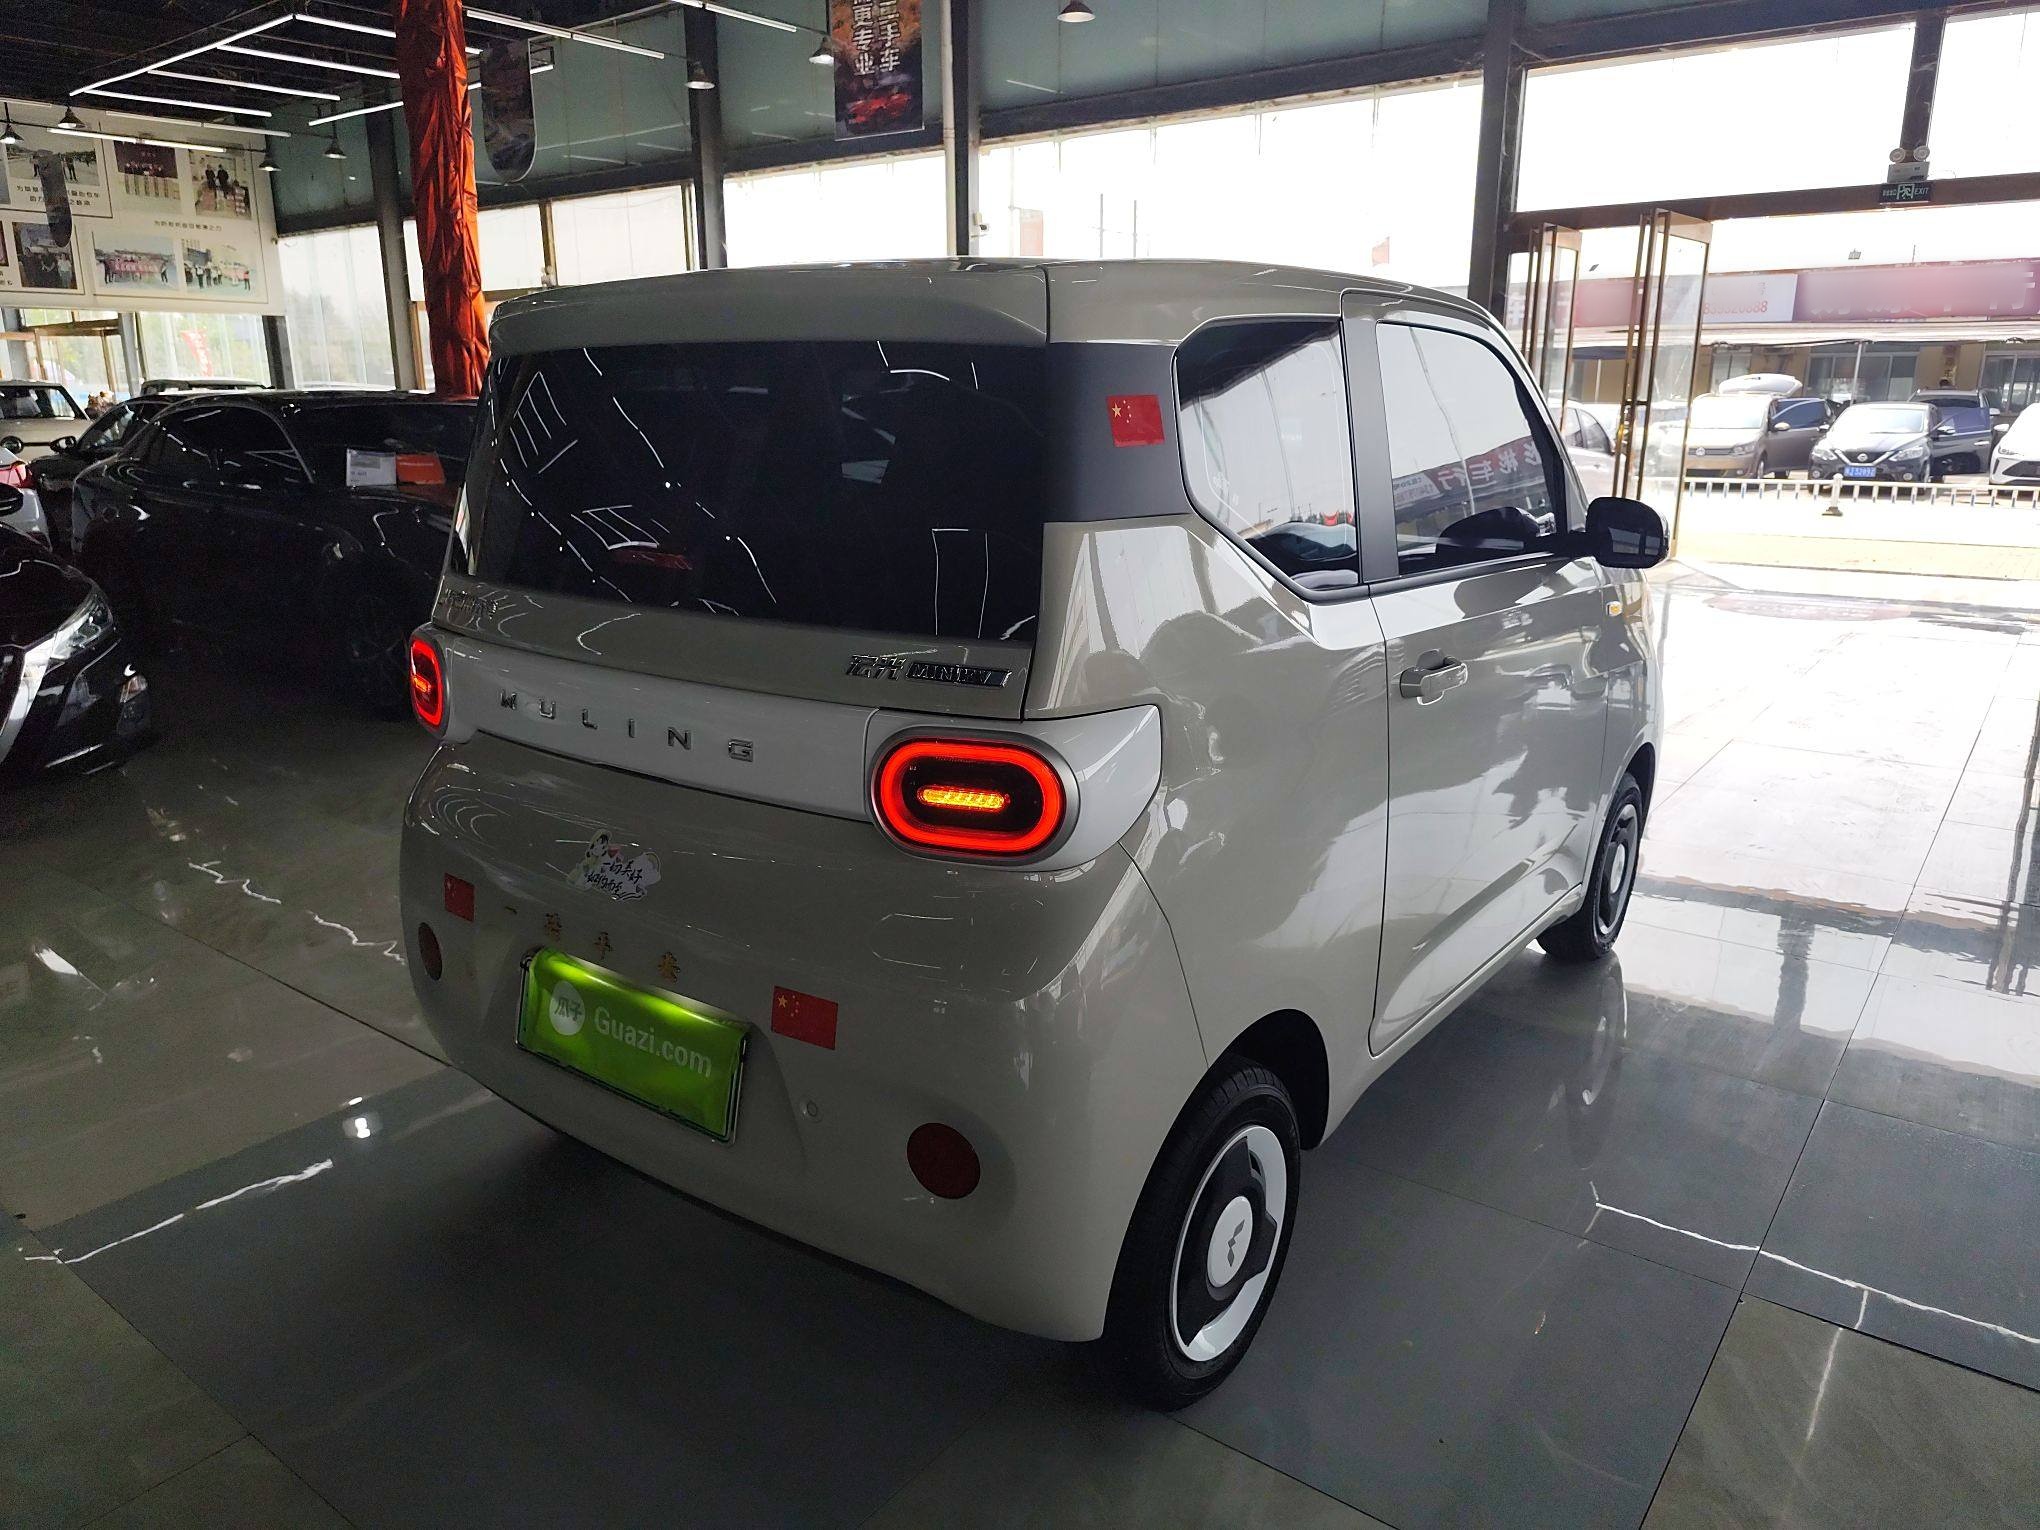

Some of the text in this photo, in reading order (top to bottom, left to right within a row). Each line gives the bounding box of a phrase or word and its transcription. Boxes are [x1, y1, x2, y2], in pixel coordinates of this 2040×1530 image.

[852, 0, 876, 76] 更专业
[1914, 187, 1929, 195] EXIT
[499, 688, 754, 763] WULING
